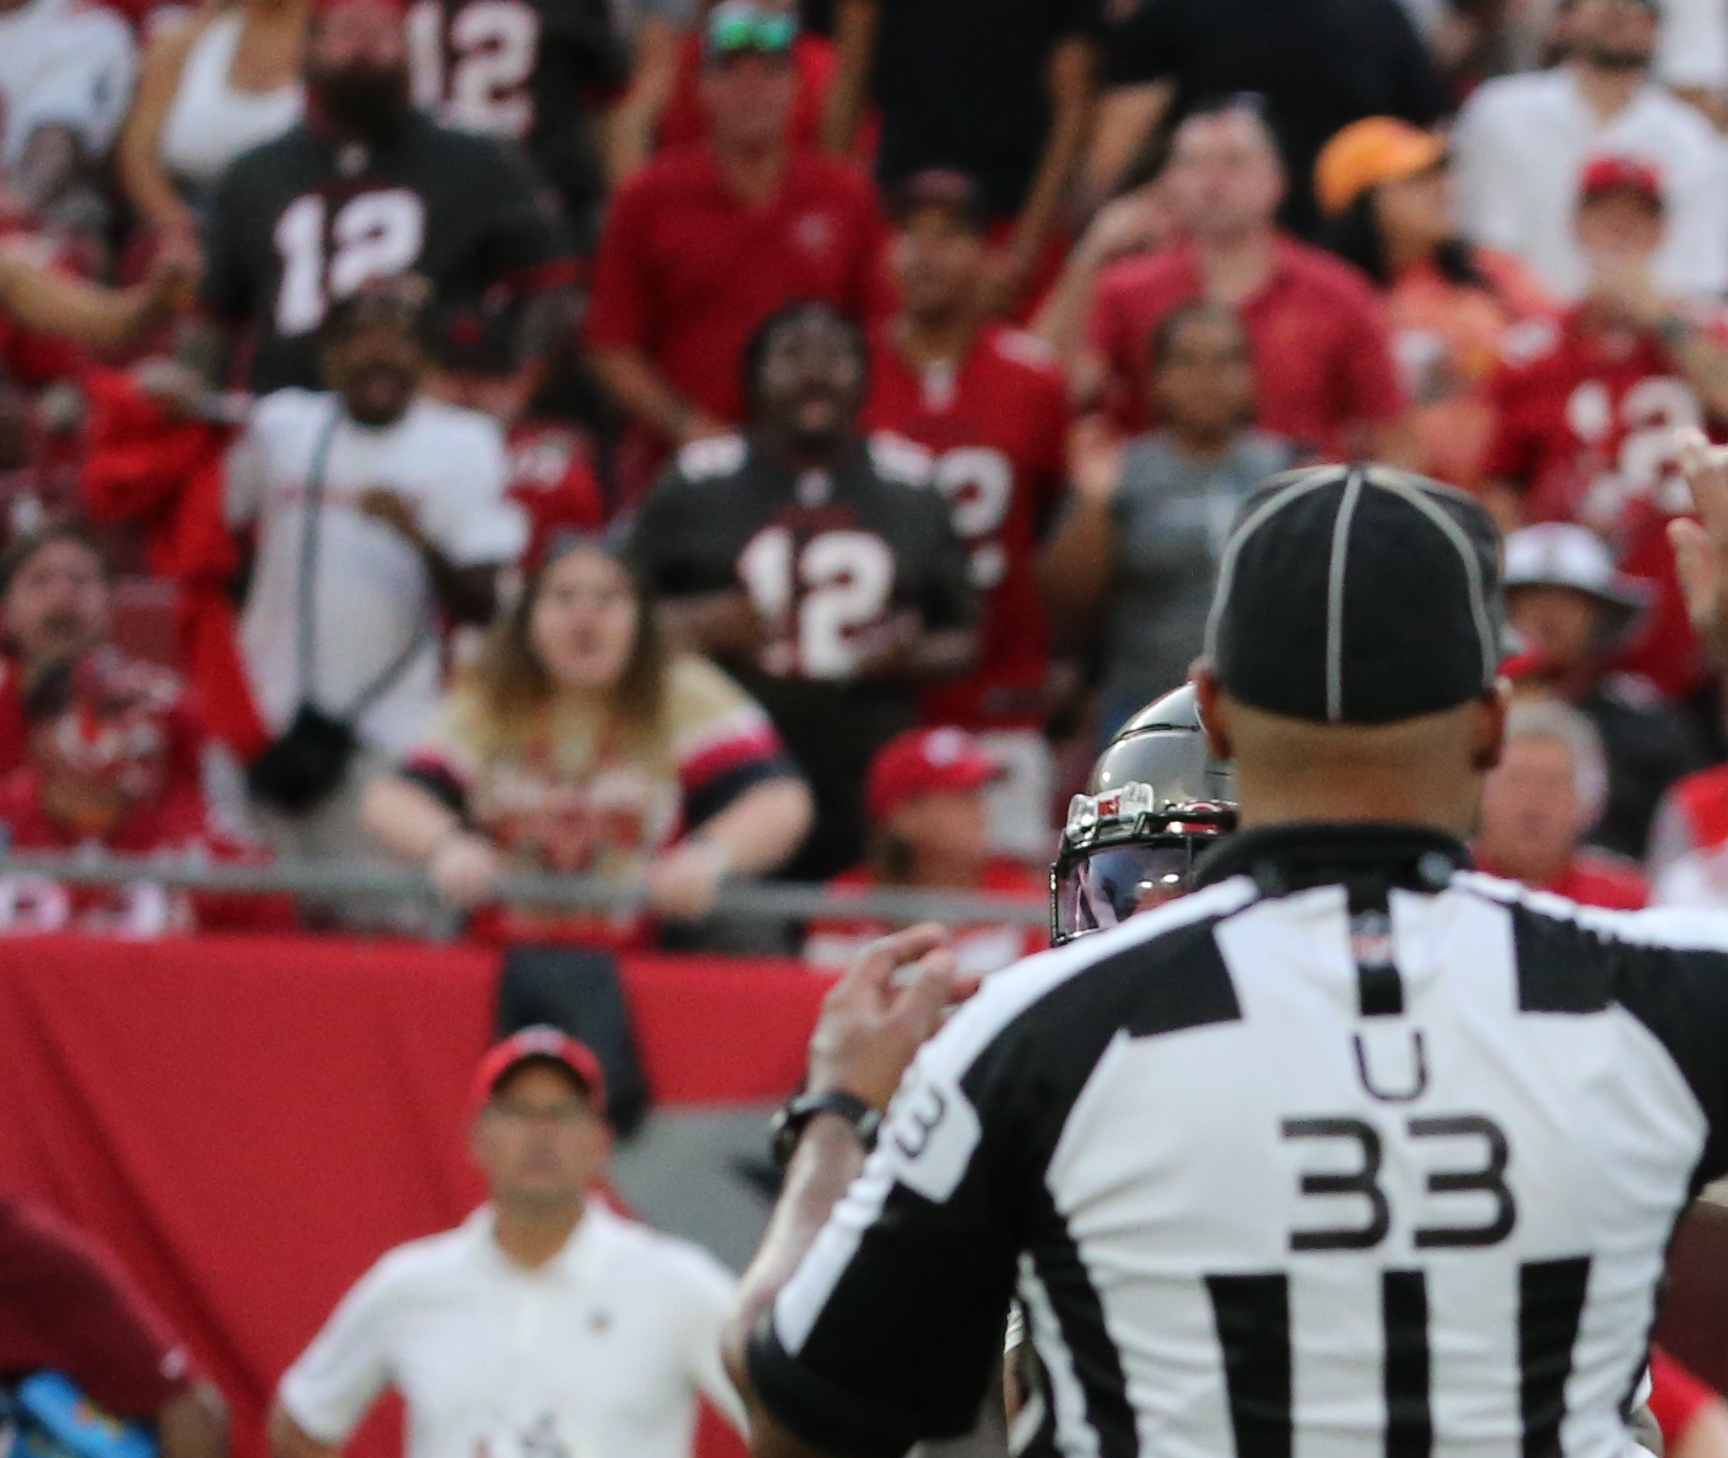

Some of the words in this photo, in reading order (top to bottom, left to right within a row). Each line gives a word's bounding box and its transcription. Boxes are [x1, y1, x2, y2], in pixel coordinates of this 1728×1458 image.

[405, 0, 541, 139] 12
[274, 188, 427, 337] 12
[737, 527, 896, 679] 12
[1352, 1030, 1427, 1102] U
[1280, 1116, 1518, 1253] 33
